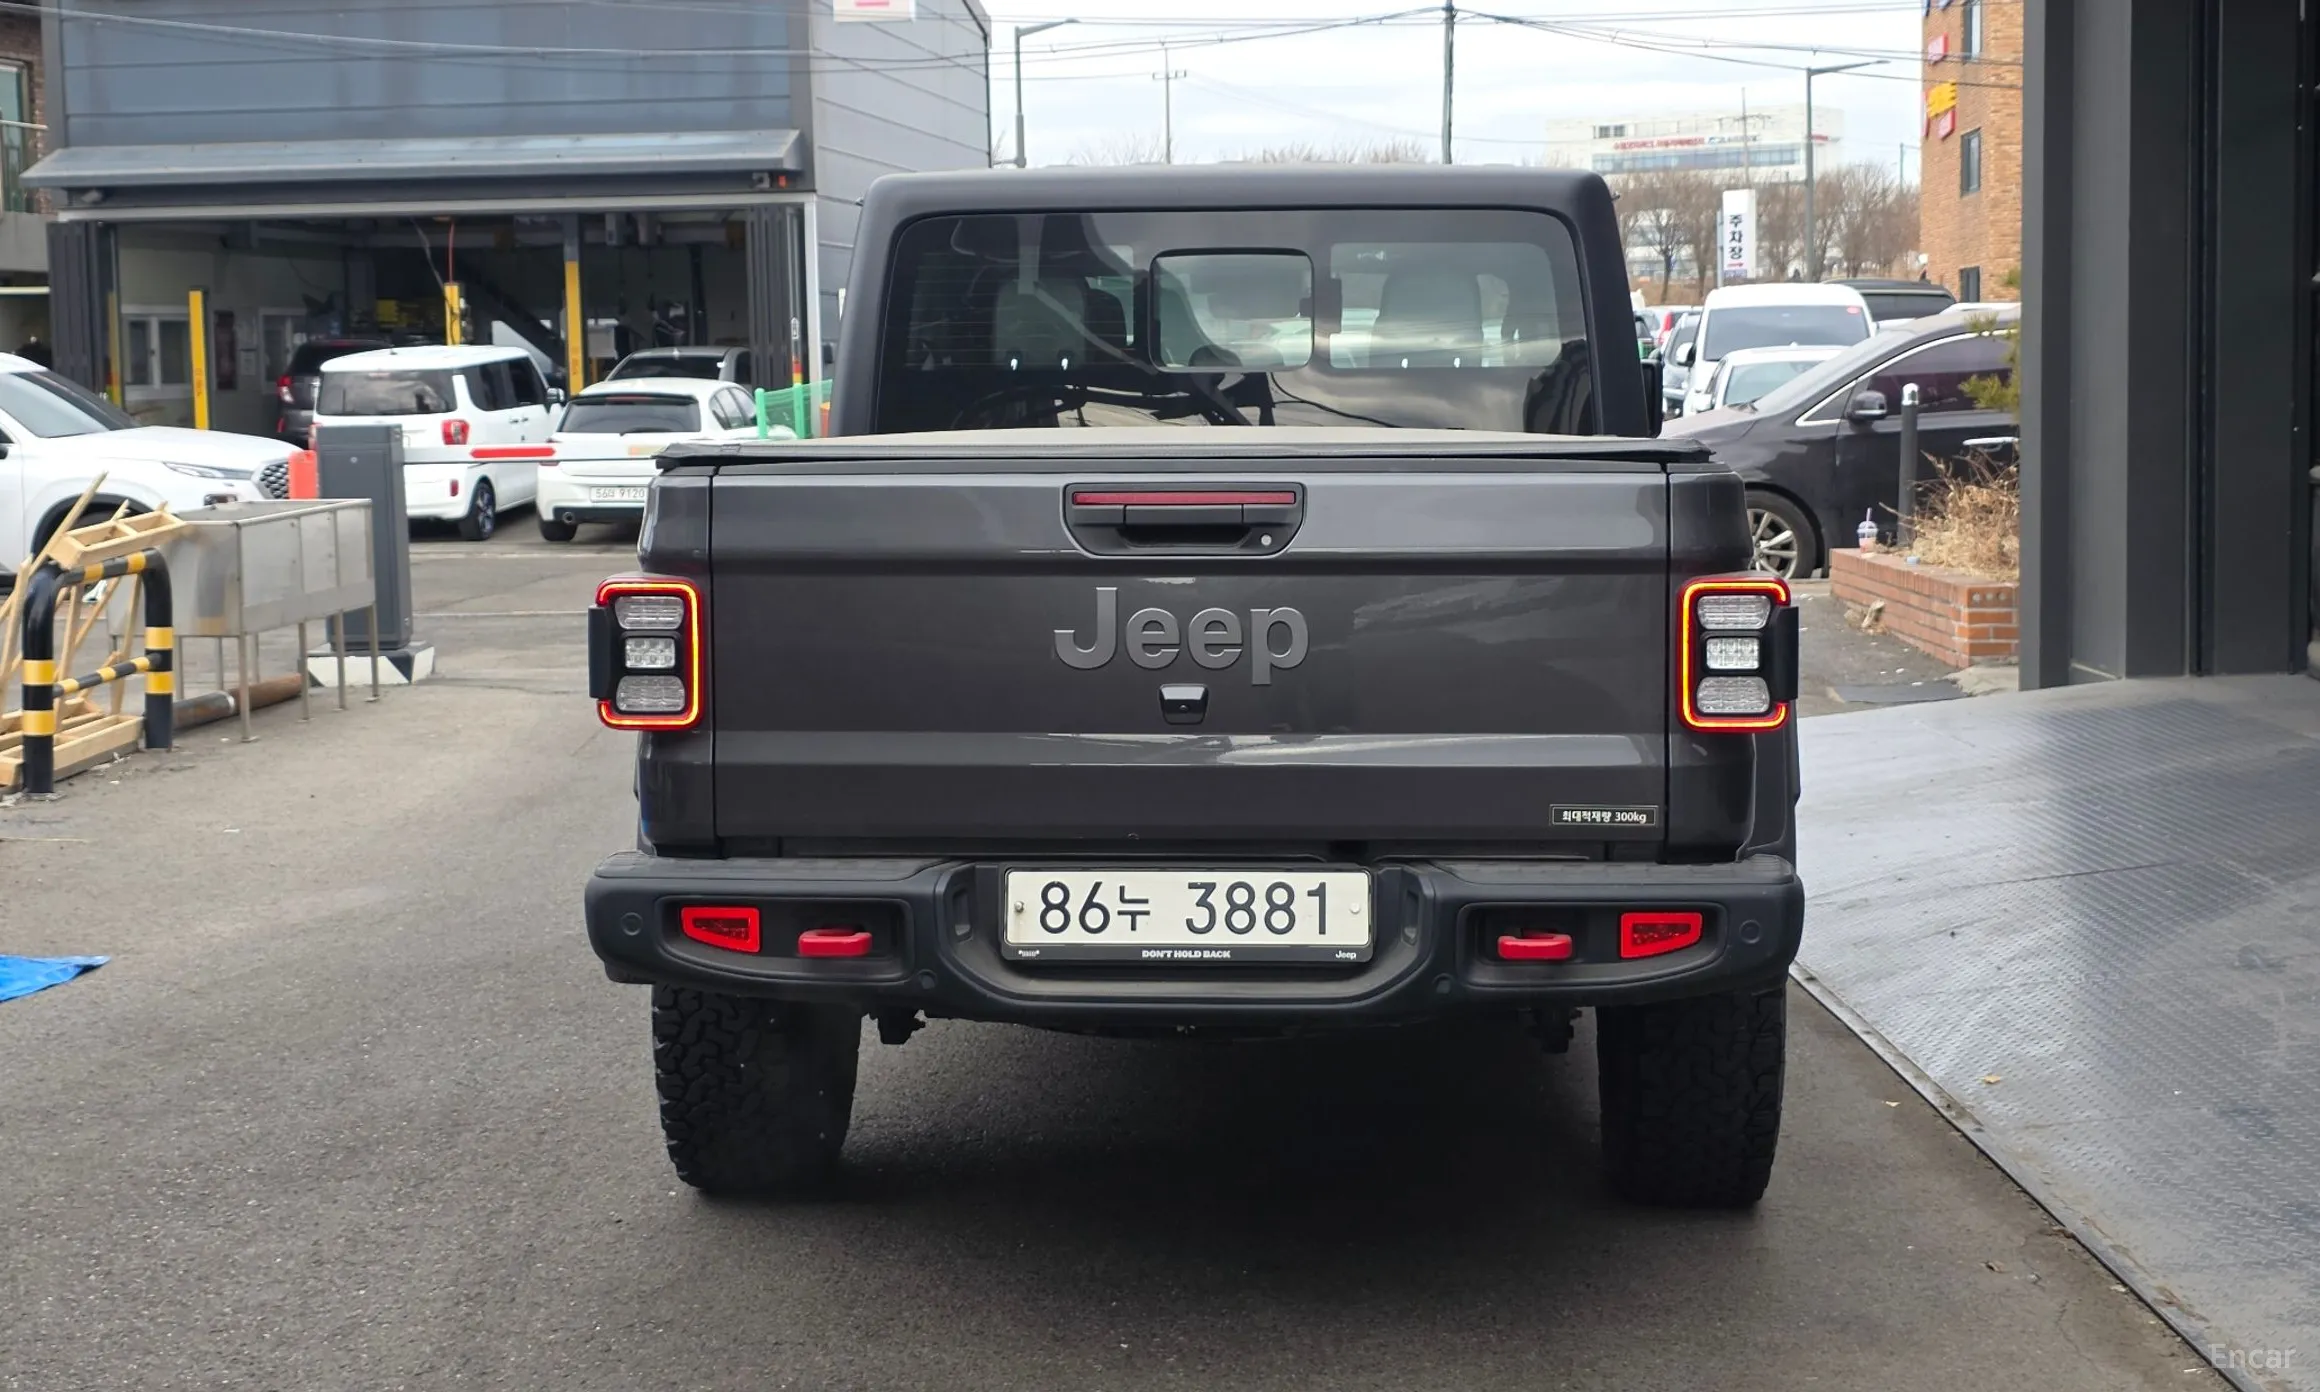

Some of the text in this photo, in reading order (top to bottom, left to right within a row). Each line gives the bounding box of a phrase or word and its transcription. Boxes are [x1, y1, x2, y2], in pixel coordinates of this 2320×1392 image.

[1728, 214, 1743, 260] 주차장
[619, 488, 645, 498] 9120
[1054, 586, 1309, 686] Jeep
[1562, 810, 1647, 825] 최대적재량 300kg
[1039, 881, 1328, 935] 86누 3881
[1141, 949, 1231, 958] DON'T HOLD BACK
[1335, 950, 1357, 960] Jeep
